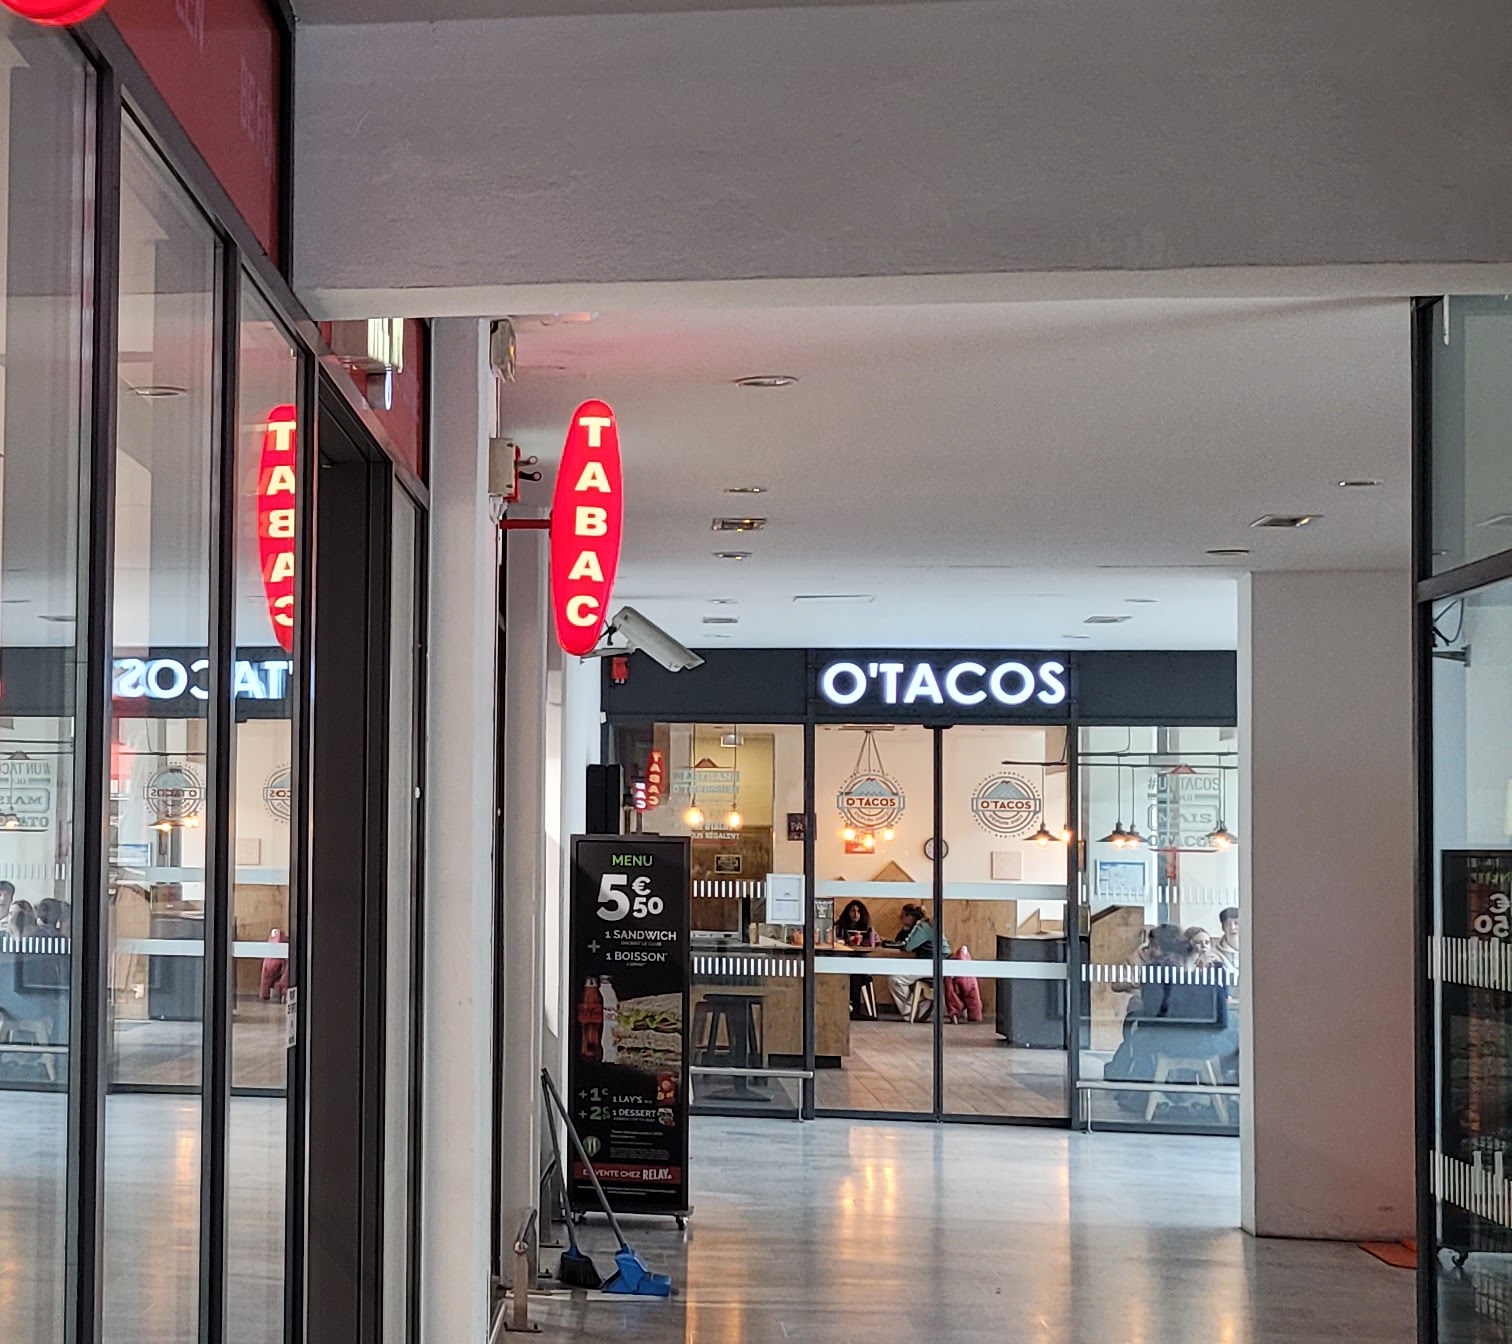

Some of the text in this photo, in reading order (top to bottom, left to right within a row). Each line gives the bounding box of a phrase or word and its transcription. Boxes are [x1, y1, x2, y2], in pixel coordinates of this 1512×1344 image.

[566, 416, 612, 627] TABAC
[823, 661, 1066, 705] O'TACOS
[845, 797, 896, 807] O'TACOS
[980, 800, 1032, 810] O'TACOS
[612, 854, 653, 867] MENU
[613, 929, 677, 941] SANDWICH
[618, 1109, 657, 1118] DESSERT
